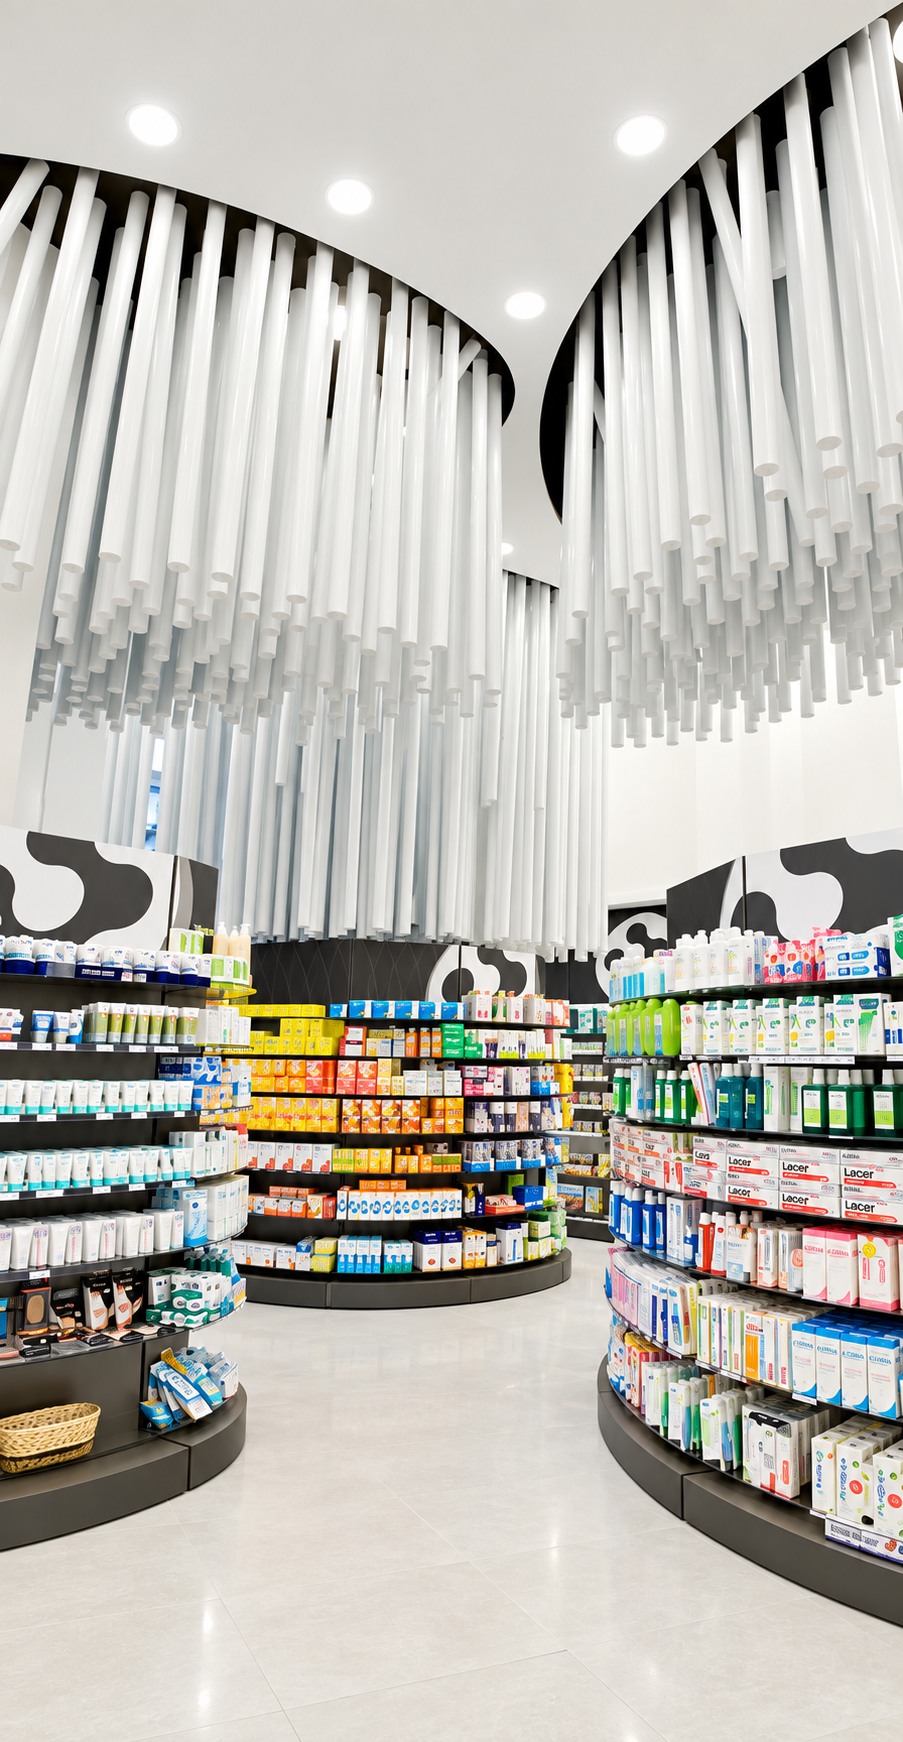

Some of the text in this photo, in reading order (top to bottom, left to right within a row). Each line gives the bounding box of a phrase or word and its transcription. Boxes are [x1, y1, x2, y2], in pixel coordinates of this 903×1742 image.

[782, 1161, 809, 1173] Lacer
[844, 1167, 874, 1180] Lacer
[782, 1193, 809, 1205] Lacer
[844, 1200, 875, 1213] Lacer
